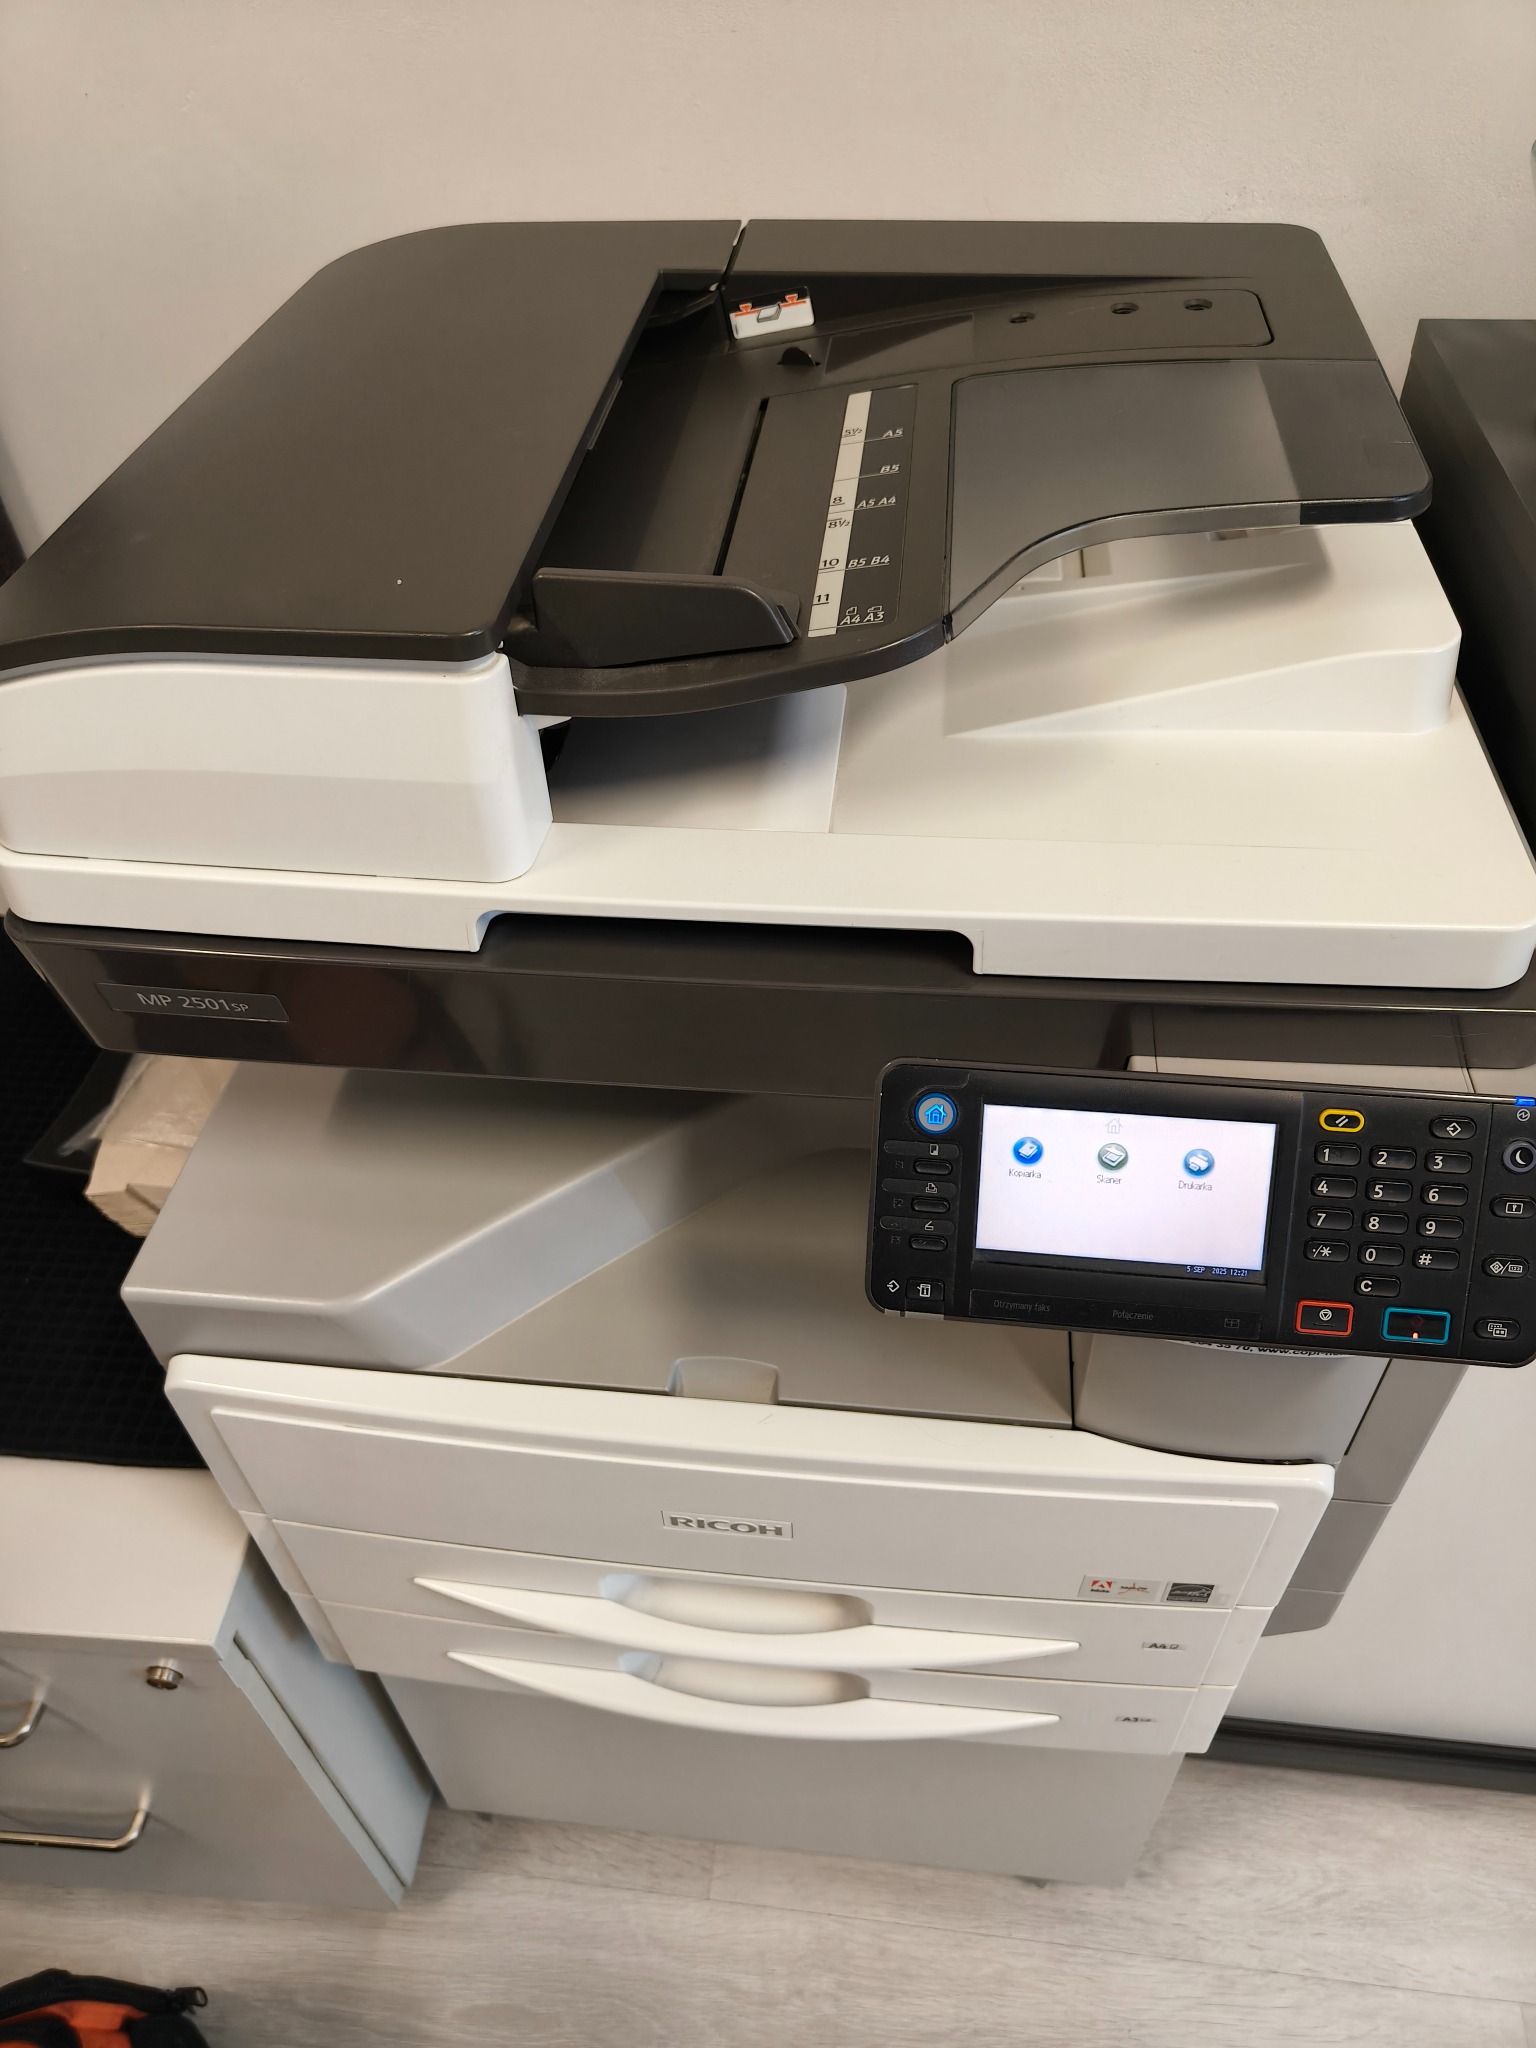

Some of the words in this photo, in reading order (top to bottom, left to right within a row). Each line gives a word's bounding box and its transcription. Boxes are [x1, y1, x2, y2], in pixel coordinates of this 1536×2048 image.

[882, 427, 904, 438] A5
[880, 464, 900, 474] B5
[832, 496, 843, 504] 8
[856, 498, 876, 509] A5
[877, 495, 896, 506] A4
[822, 558, 840, 567] 10
[848, 557, 868, 568] B5
[870, 554, 890, 566] B4
[816, 593, 830, 602] 11
[840, 614, 861, 625] A4
[863, 611, 885, 623] A3
[136, 992, 172, 1007] MP
[1322, 1148, 1330, 1162] 1
[1376, 1151, 1388, 1165] 2
[1433, 1155, 1444, 1169] 3
[1008, 1168, 1042, 1180] Kopiarka
[1096, 1175, 1123, 1185] Skaner
[1178, 1180, 1213, 1192] Drukarka
[1317, 1180, 1329, 1194] 4
[1373, 1184, 1384, 1198] 5
[1428, 1188, 1440, 1202] 6
[1316, 1213, 1327, 1227] 7
[1368, 1216, 1380, 1230] 8
[1425, 1221, 1436, 1235] 9
[1365, 1248, 1377, 1262] 0
[1418, 1253, 1433, 1266] #
[1186, 1265, 1191, 1273] 5
[1211, 1267, 1227, 1275] 2025
[1230, 1269, 1248, 1277] 12:21
[1360, 1280, 1373, 1292] C
[993, 1299, 1032, 1312] Otrzymany
[1034, 1303, 1050, 1312] faks
[1112, 1309, 1154, 1321] Połączenie
[669, 1514, 783, 1537] RICOH
